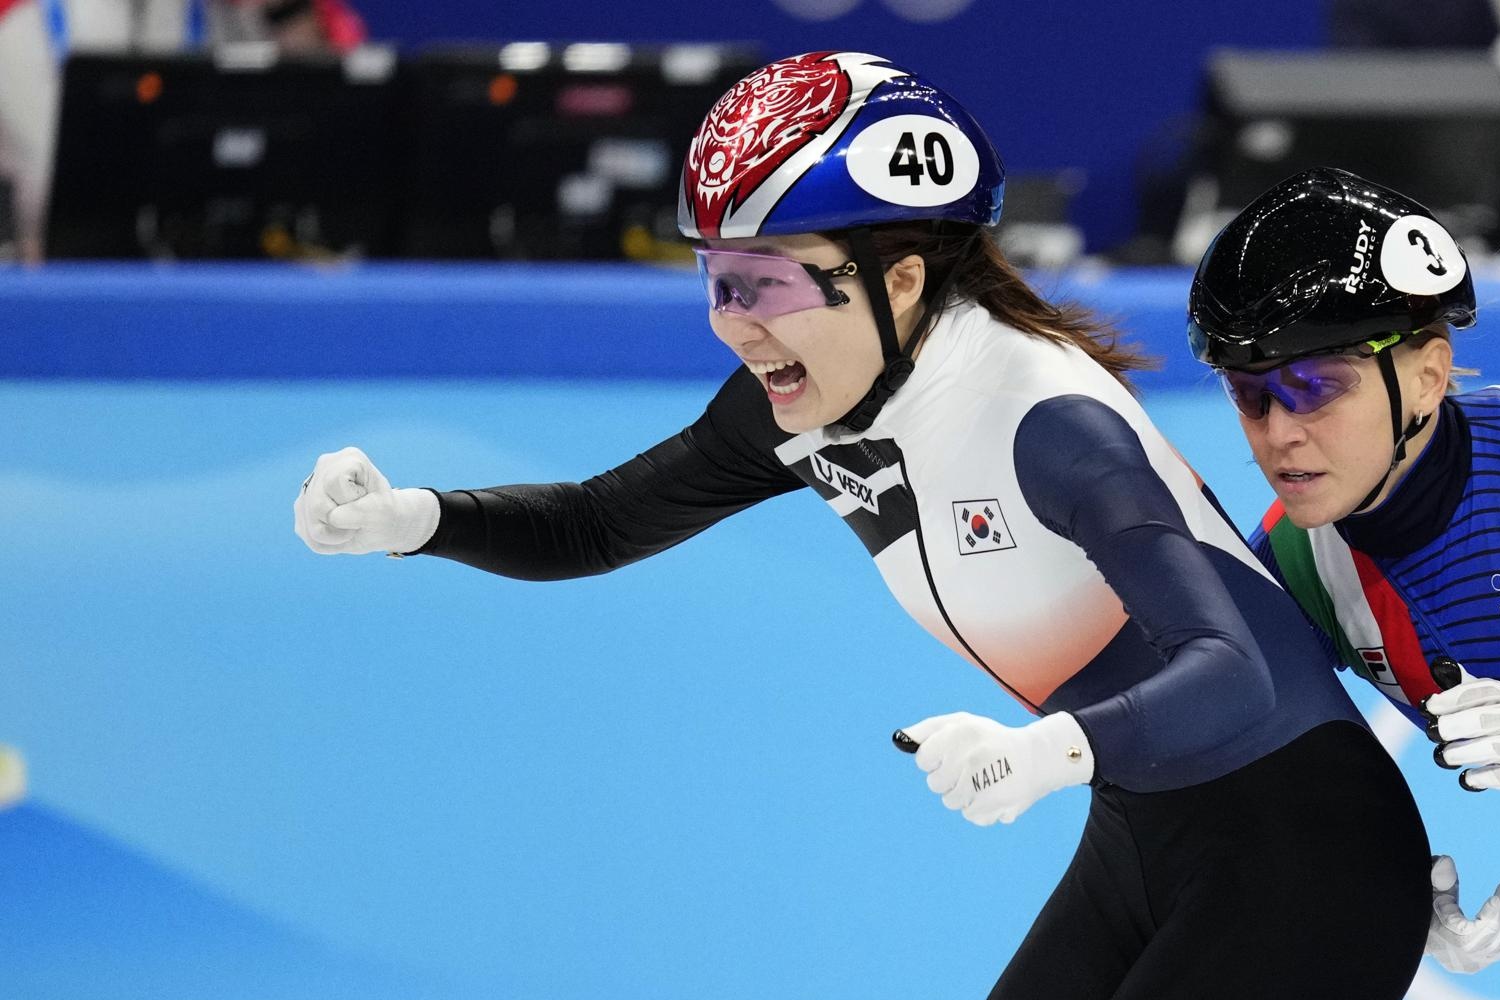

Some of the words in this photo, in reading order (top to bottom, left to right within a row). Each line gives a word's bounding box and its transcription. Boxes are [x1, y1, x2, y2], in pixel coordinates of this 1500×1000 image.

[889, 132, 955, 186] 40
[1345, 219, 1371, 294] RUDY
[1359, 228, 1377, 290] PROJECT
[1408, 229, 1449, 277] 3
